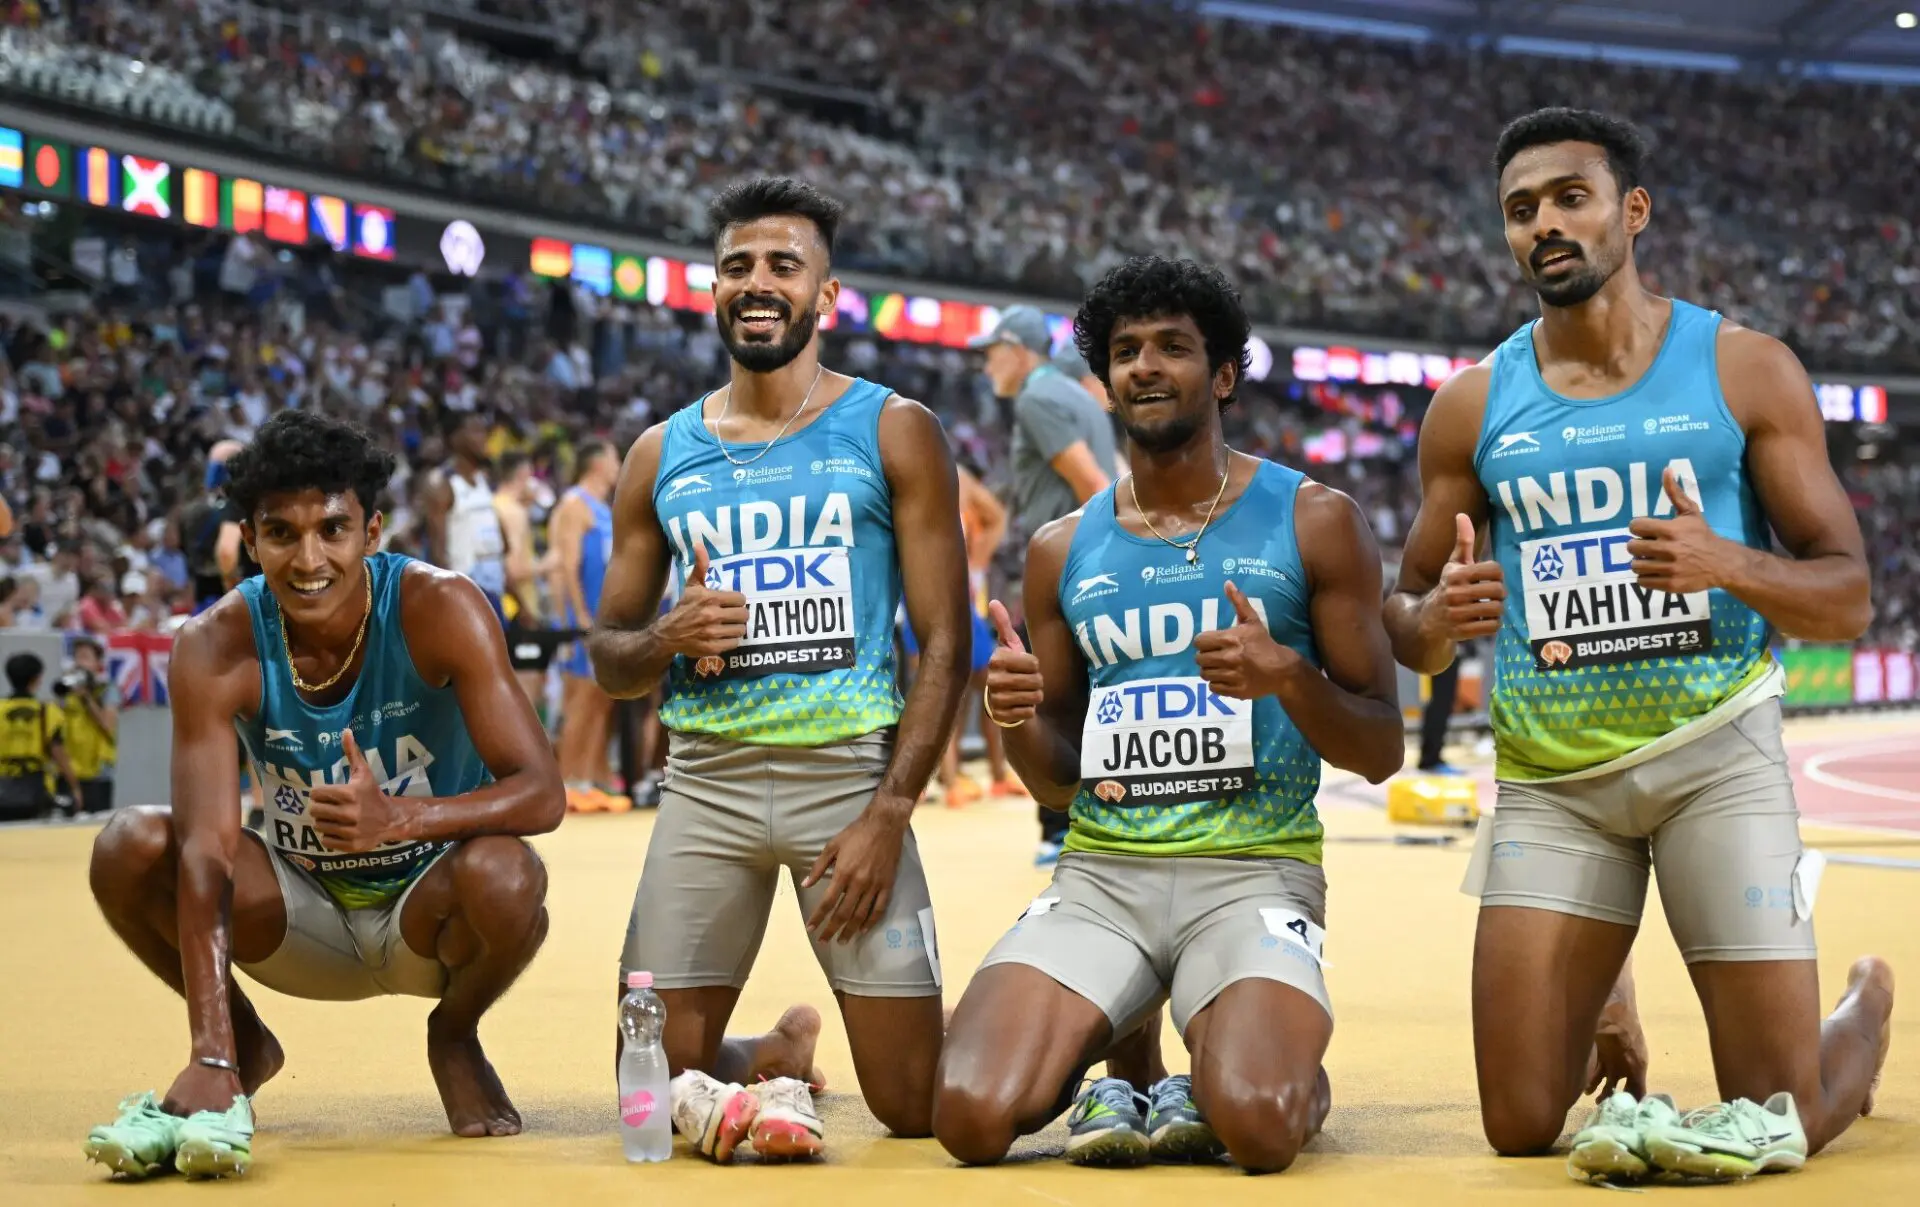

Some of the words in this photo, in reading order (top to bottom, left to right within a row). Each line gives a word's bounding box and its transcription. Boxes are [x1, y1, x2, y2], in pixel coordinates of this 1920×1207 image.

[1659, 414, 1690, 424] INDIAN
[1659, 421, 1710, 433] ATHLETICS
[1576, 433, 1626, 445] Foundation
[1577, 424, 1626, 437] Reliance
[746, 465, 793, 479] Reliance
[746, 474, 792, 486] Foundation
[825, 466, 872, 478] ATHLETICS
[1497, 458, 1704, 533] INDIA
[668, 492, 855, 567] INDIA
[1237, 557, 1268, 567] INDIAN
[1561, 535, 1636, 577] TD
[722, 553, 836, 592] TDK
[1156, 562, 1205, 577] Reliance
[1237, 566, 1286, 580] ATHLETICS
[1156, 572, 1204, 585] Foundation
[1539, 582, 1691, 631] YAHIYA
[1576, 633, 1675, 657] BUDAPEST
[1676, 630, 1700, 646] 23
[729, 649, 821, 669] BUDAPEST
[822, 647, 843, 661] 23
[1123, 683, 1237, 721] TDK
[1103, 727, 1227, 771] JACOB
[1131, 778, 1220, 797] BUDAPEST
[1222, 777, 1244, 791] 23
[321, 850, 412, 872] BUDAPEST
[415, 842, 434, 856] 23
